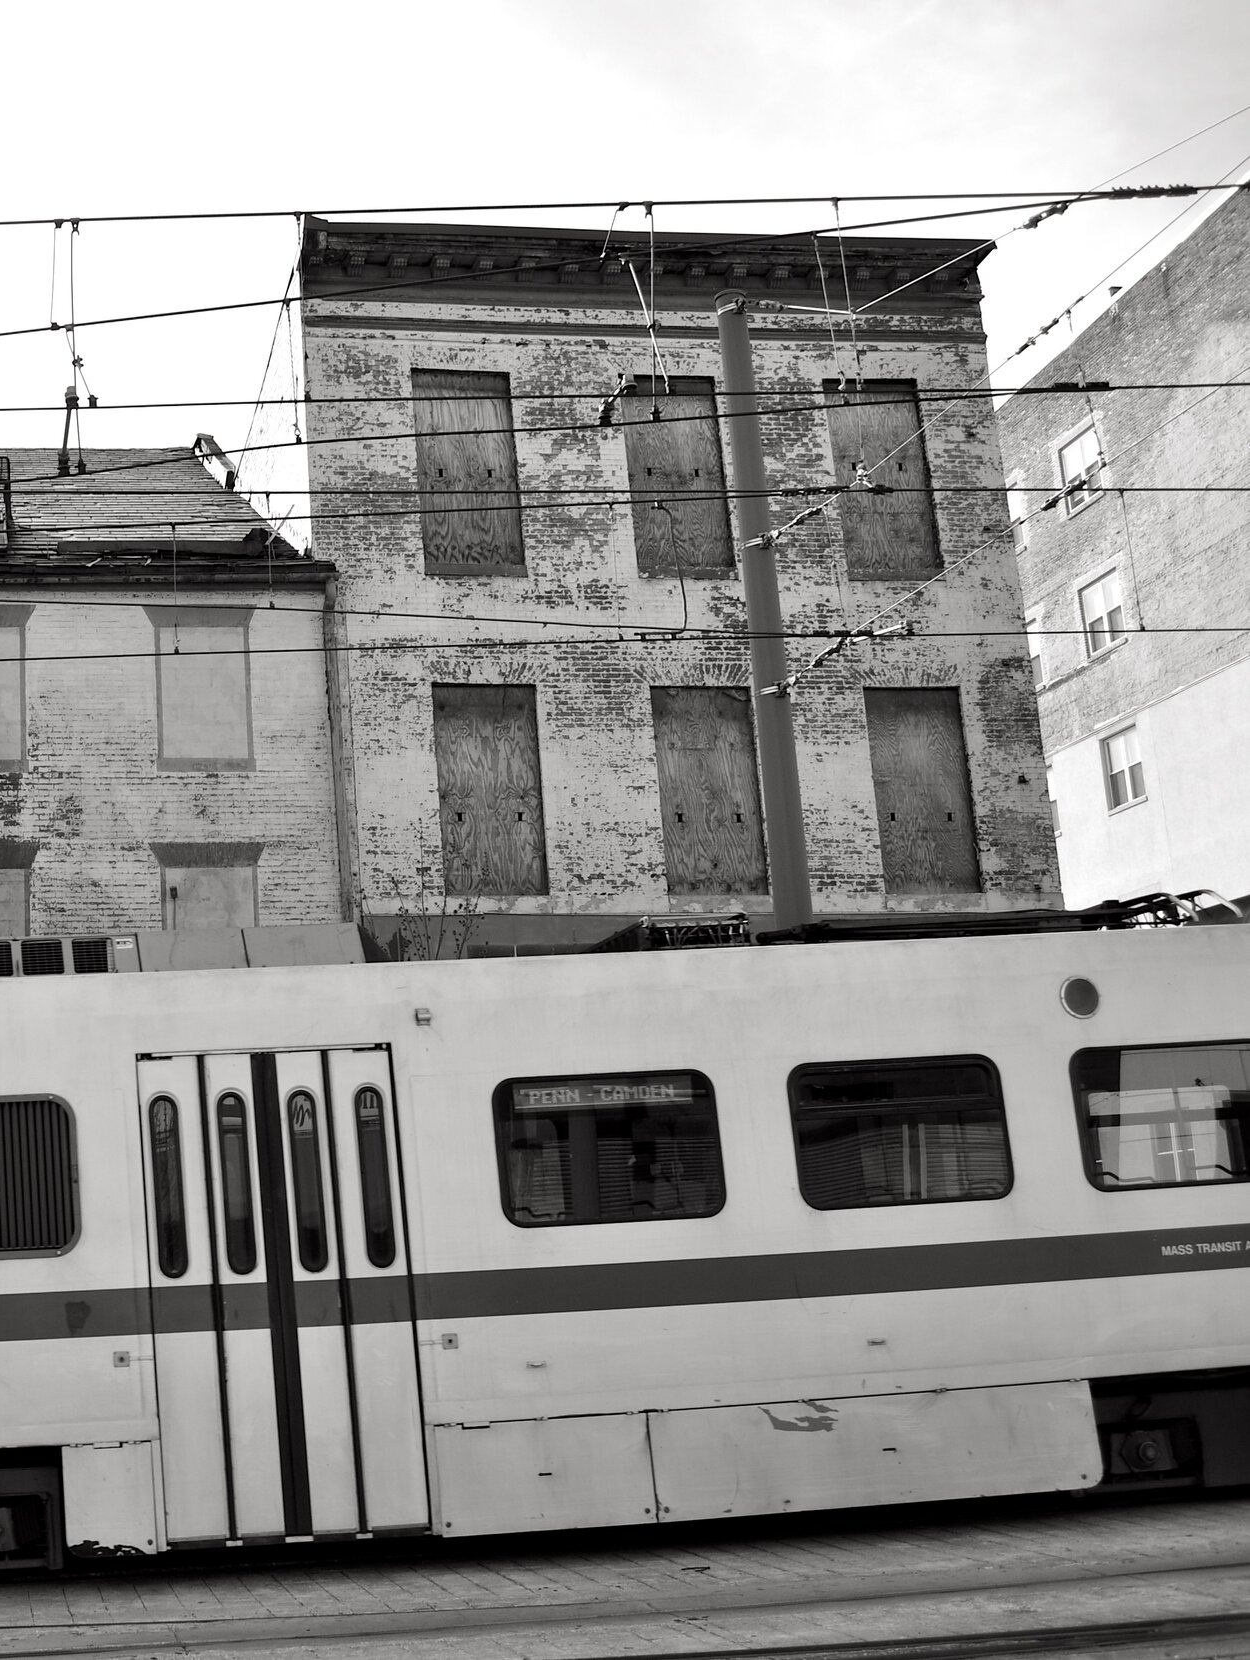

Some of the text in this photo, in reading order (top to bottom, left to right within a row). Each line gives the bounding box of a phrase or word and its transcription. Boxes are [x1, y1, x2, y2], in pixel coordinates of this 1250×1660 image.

[529, 1088, 581, 1105] PENN
[599, 1084, 675, 1101] CAMDEN
[1161, 1244, 1194, 1256] MASS
[1196, 1240, 1242, 1253] TRANSIT
